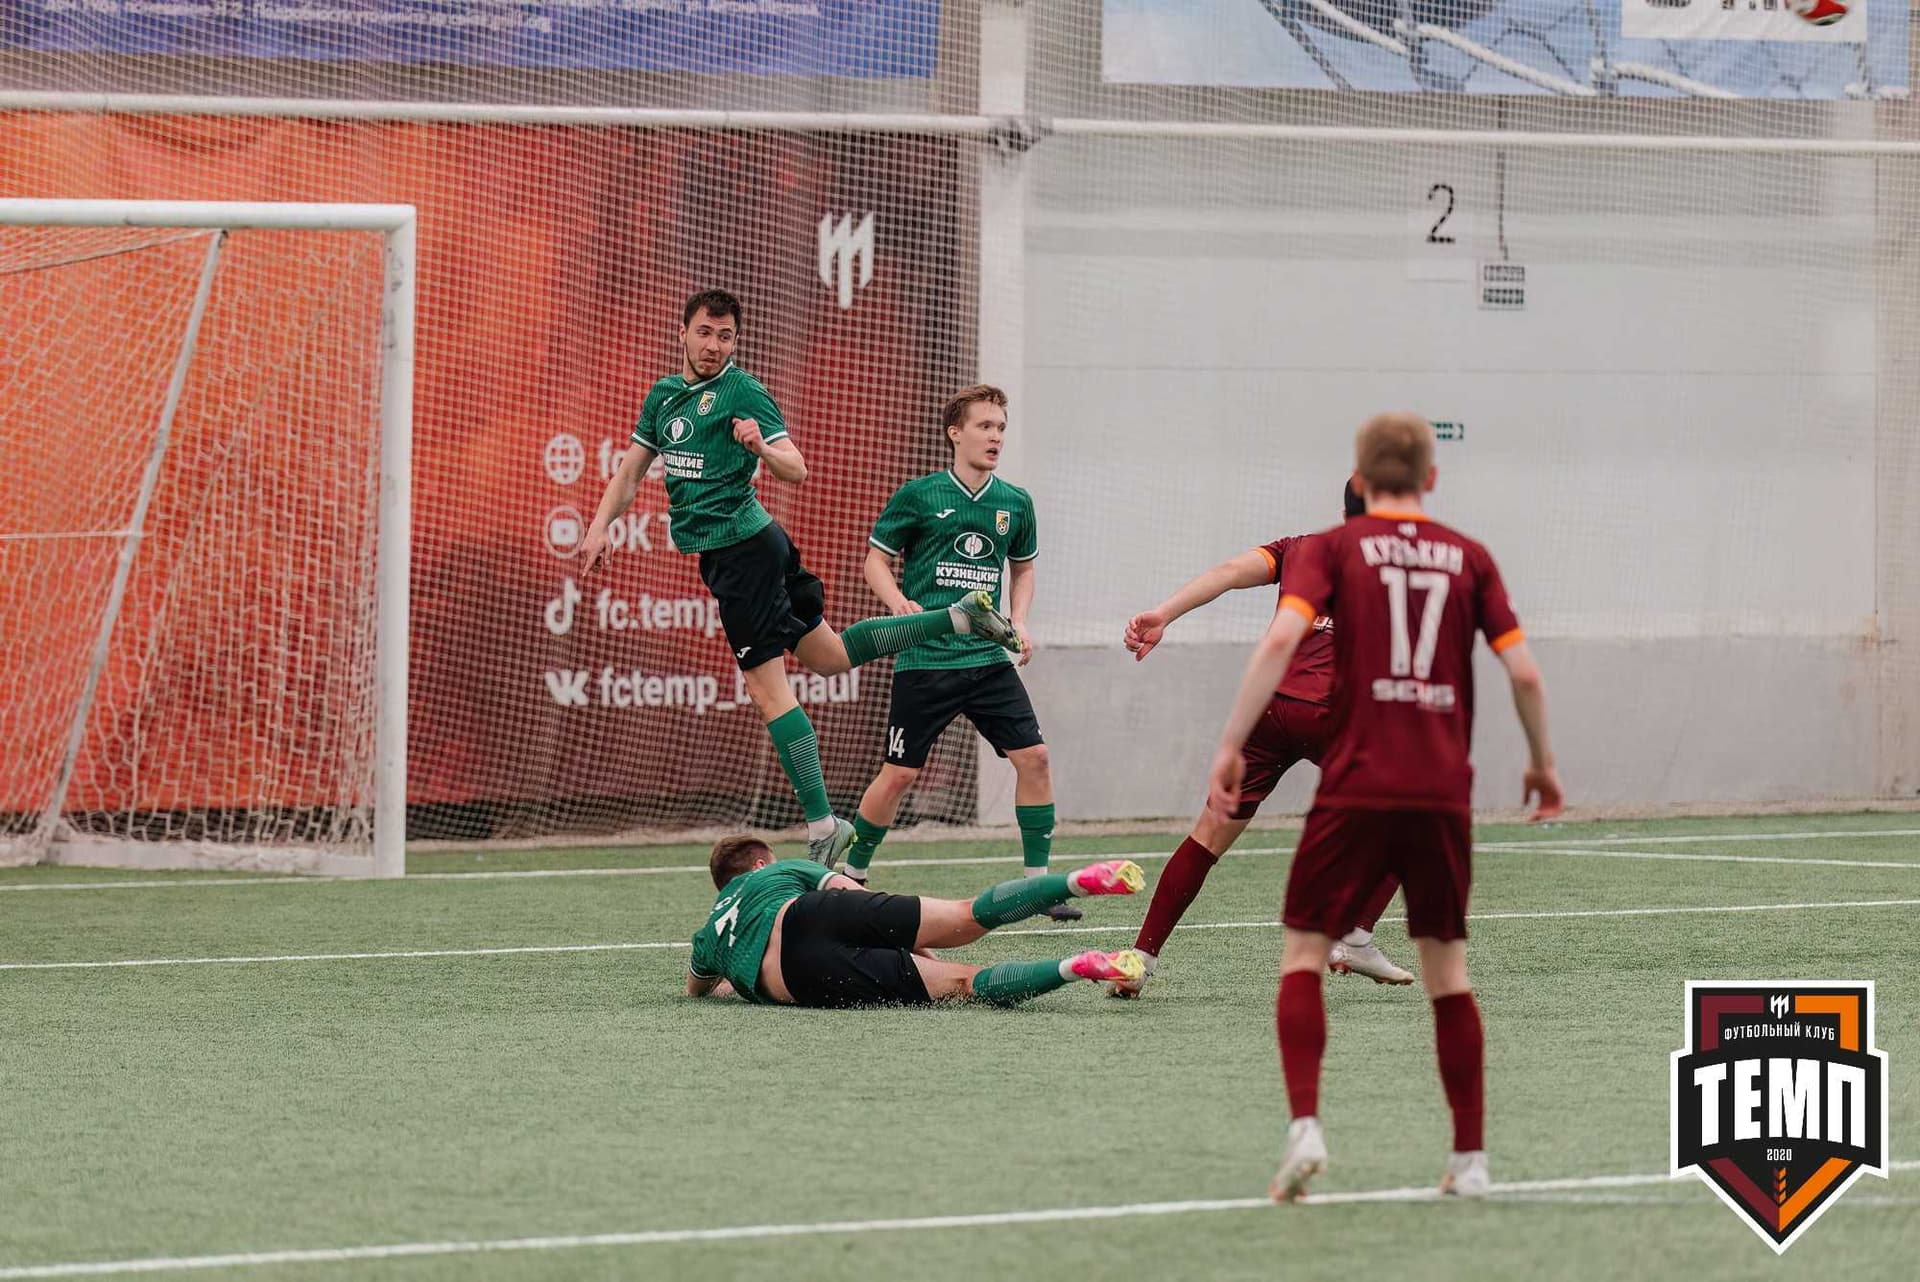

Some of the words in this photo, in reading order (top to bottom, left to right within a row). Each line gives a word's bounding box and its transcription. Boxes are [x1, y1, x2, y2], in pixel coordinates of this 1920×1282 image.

[1427, 183, 1455, 243] 2
[936, 566, 999, 583] КУЗНЕЦКИЕ
[1379, 565, 1450, 680] 17
[888, 726, 905, 759] 14
